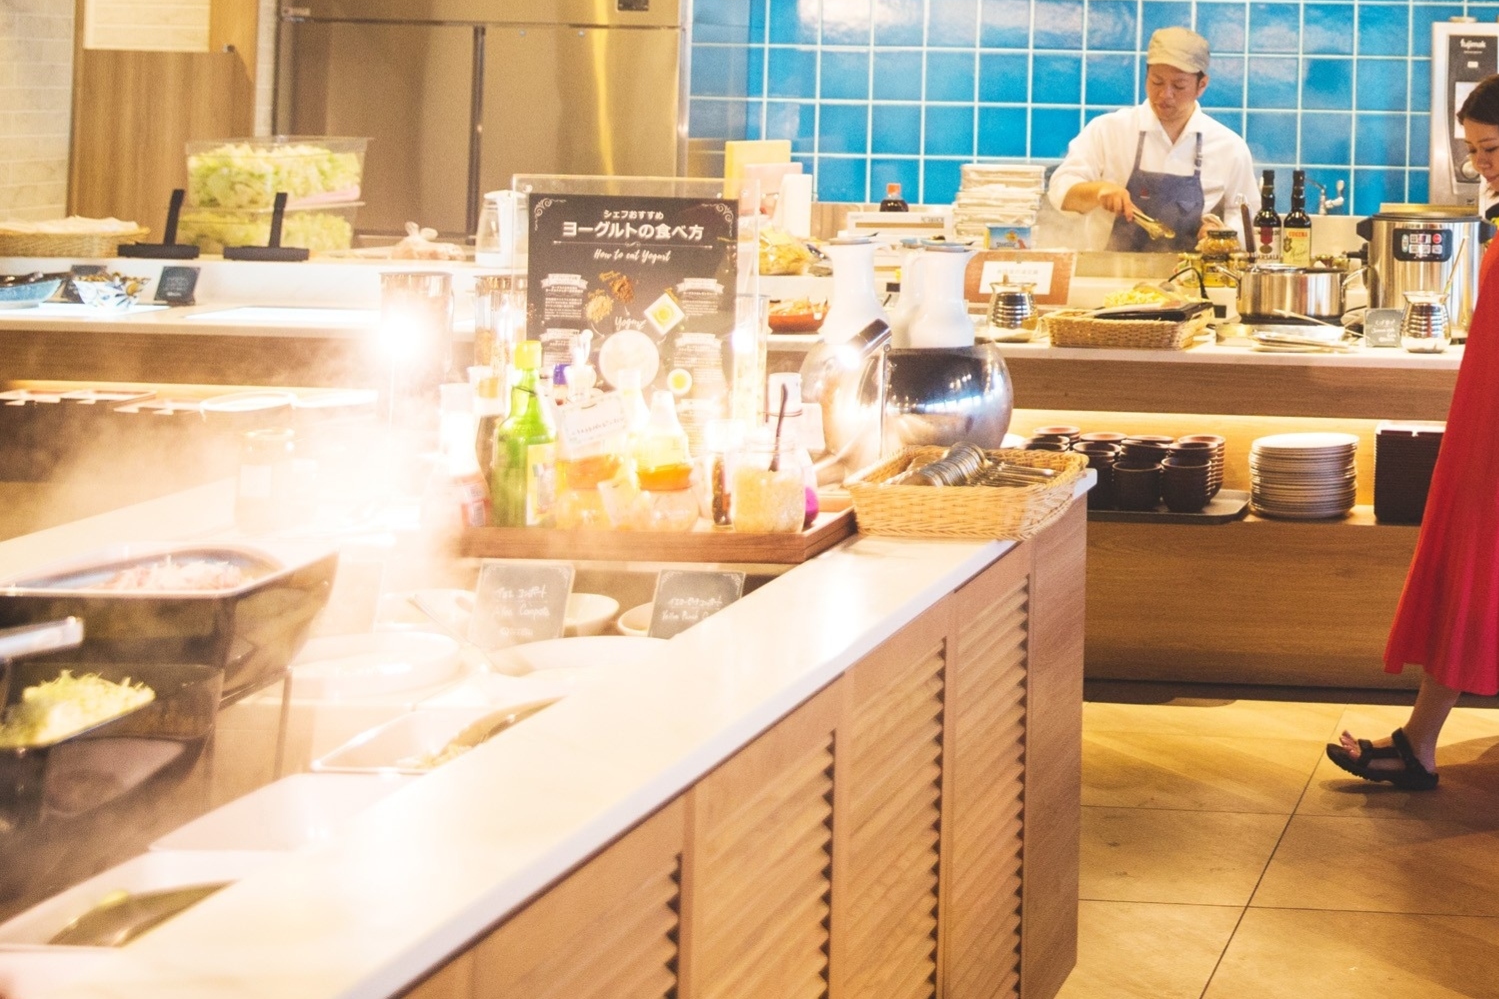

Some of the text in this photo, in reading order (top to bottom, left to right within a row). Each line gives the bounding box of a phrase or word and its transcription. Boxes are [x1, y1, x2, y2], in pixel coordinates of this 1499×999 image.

[603, 209, 664, 220] シェフおすすめ
[562, 221, 705, 240] ヨーグルトの食べ方
[594, 248, 672, 264] How to eat Yogurt
